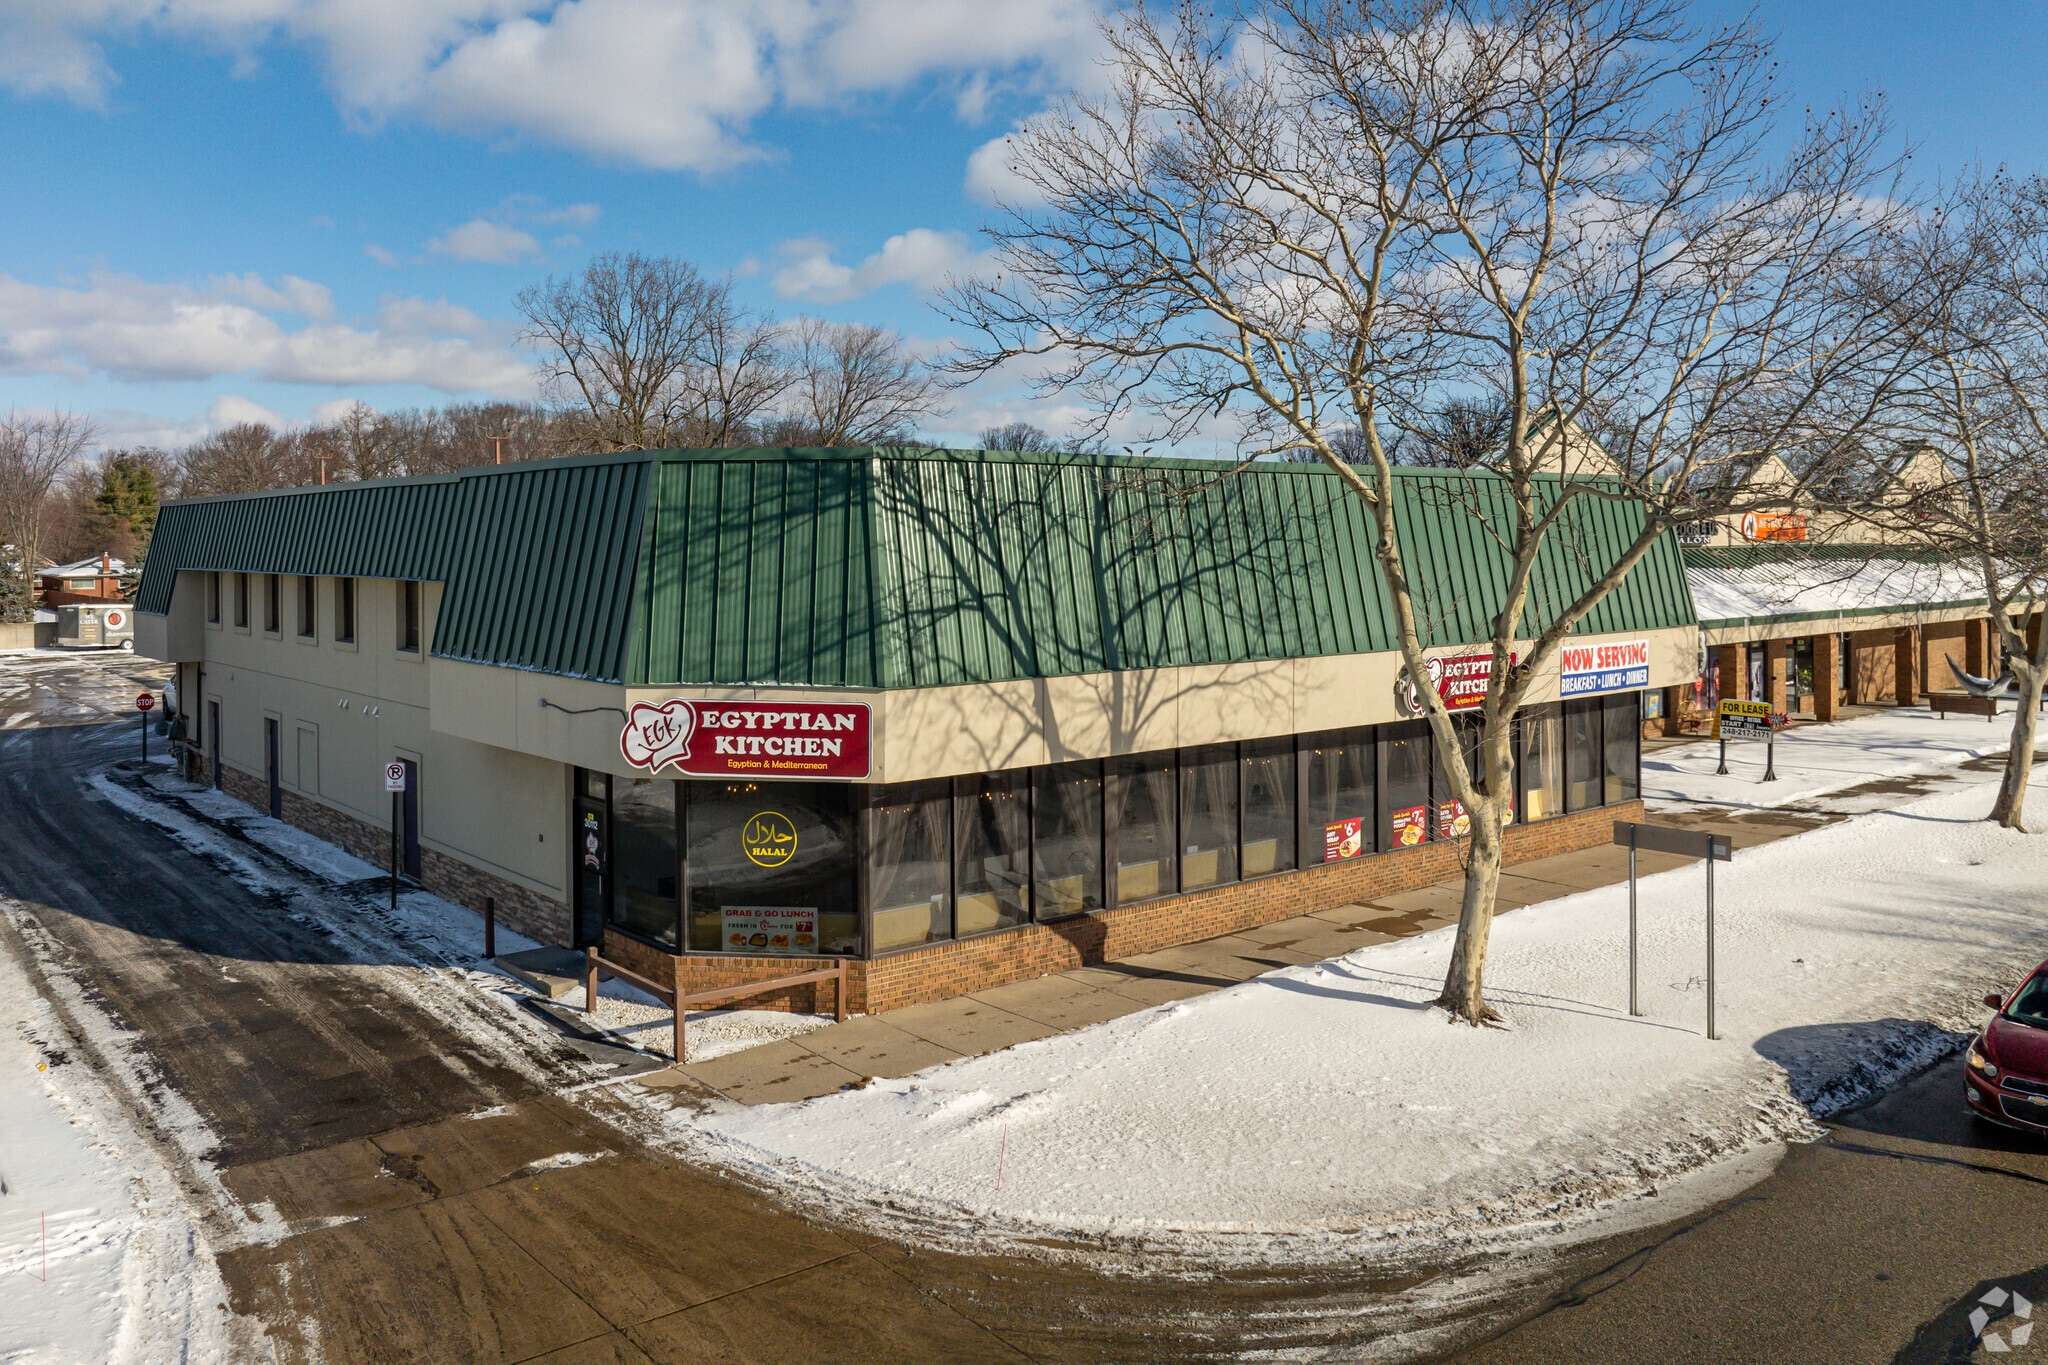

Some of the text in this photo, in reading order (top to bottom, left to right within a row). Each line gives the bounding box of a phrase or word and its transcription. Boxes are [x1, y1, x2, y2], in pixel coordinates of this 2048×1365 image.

[1562, 642, 1647, 673] NOW SERVING
[1444, 660, 1493, 678] EGYPTI
[1449, 678, 1490, 696] KITCH
[1561, 668, 1648, 694] BREAKFAST LUNCH DINNER
[137, 698, 154, 707] STOP
[1723, 703, 1769, 715] FOR LEASE
[701, 711, 856, 731] EGYPTIAN
[642, 714, 676, 748] EGK
[1722, 728, 1770, 739] 248-217-2171
[715, 736, 843, 758] KITCHEN
[728, 758, 828, 770] Egyptian & Mediterranean
[746, 820, 793, 845] حلال
[752, 847, 787, 856] HALAL
[725, 909, 752, 917] GRAB
[754, 909, 762, 917] &
